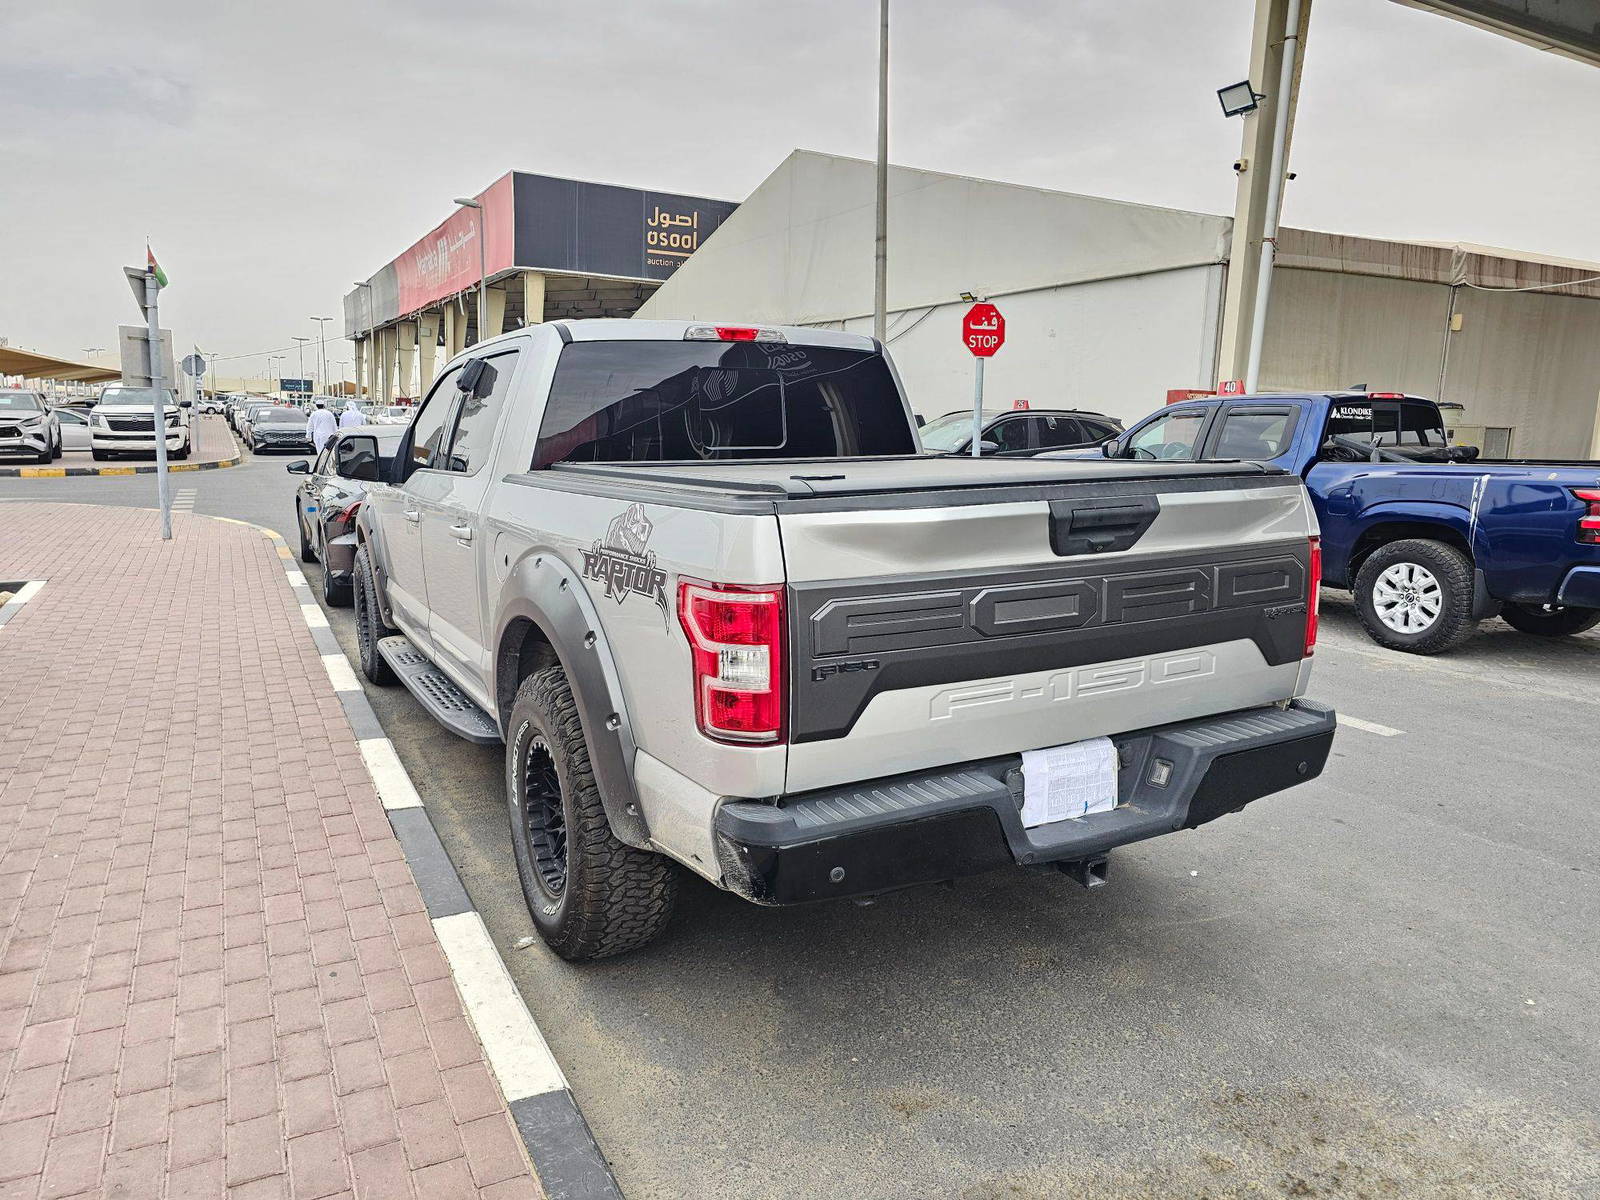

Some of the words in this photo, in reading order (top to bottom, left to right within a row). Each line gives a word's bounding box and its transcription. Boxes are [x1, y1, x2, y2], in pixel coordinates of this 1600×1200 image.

[647, 206, 698, 228] اصول
[647, 258, 674, 267] auction
[969, 312, 998, 330] قف
[969, 335, 998, 348] STOP
[1224, 382, 1236, 393] 40
[1340, 406, 1372, 416] KLONDIKE
[578, 548, 668, 606] RAPTOR
[809, 553, 1305, 659] FORD
[929, 650, 1217, 720] F-150
